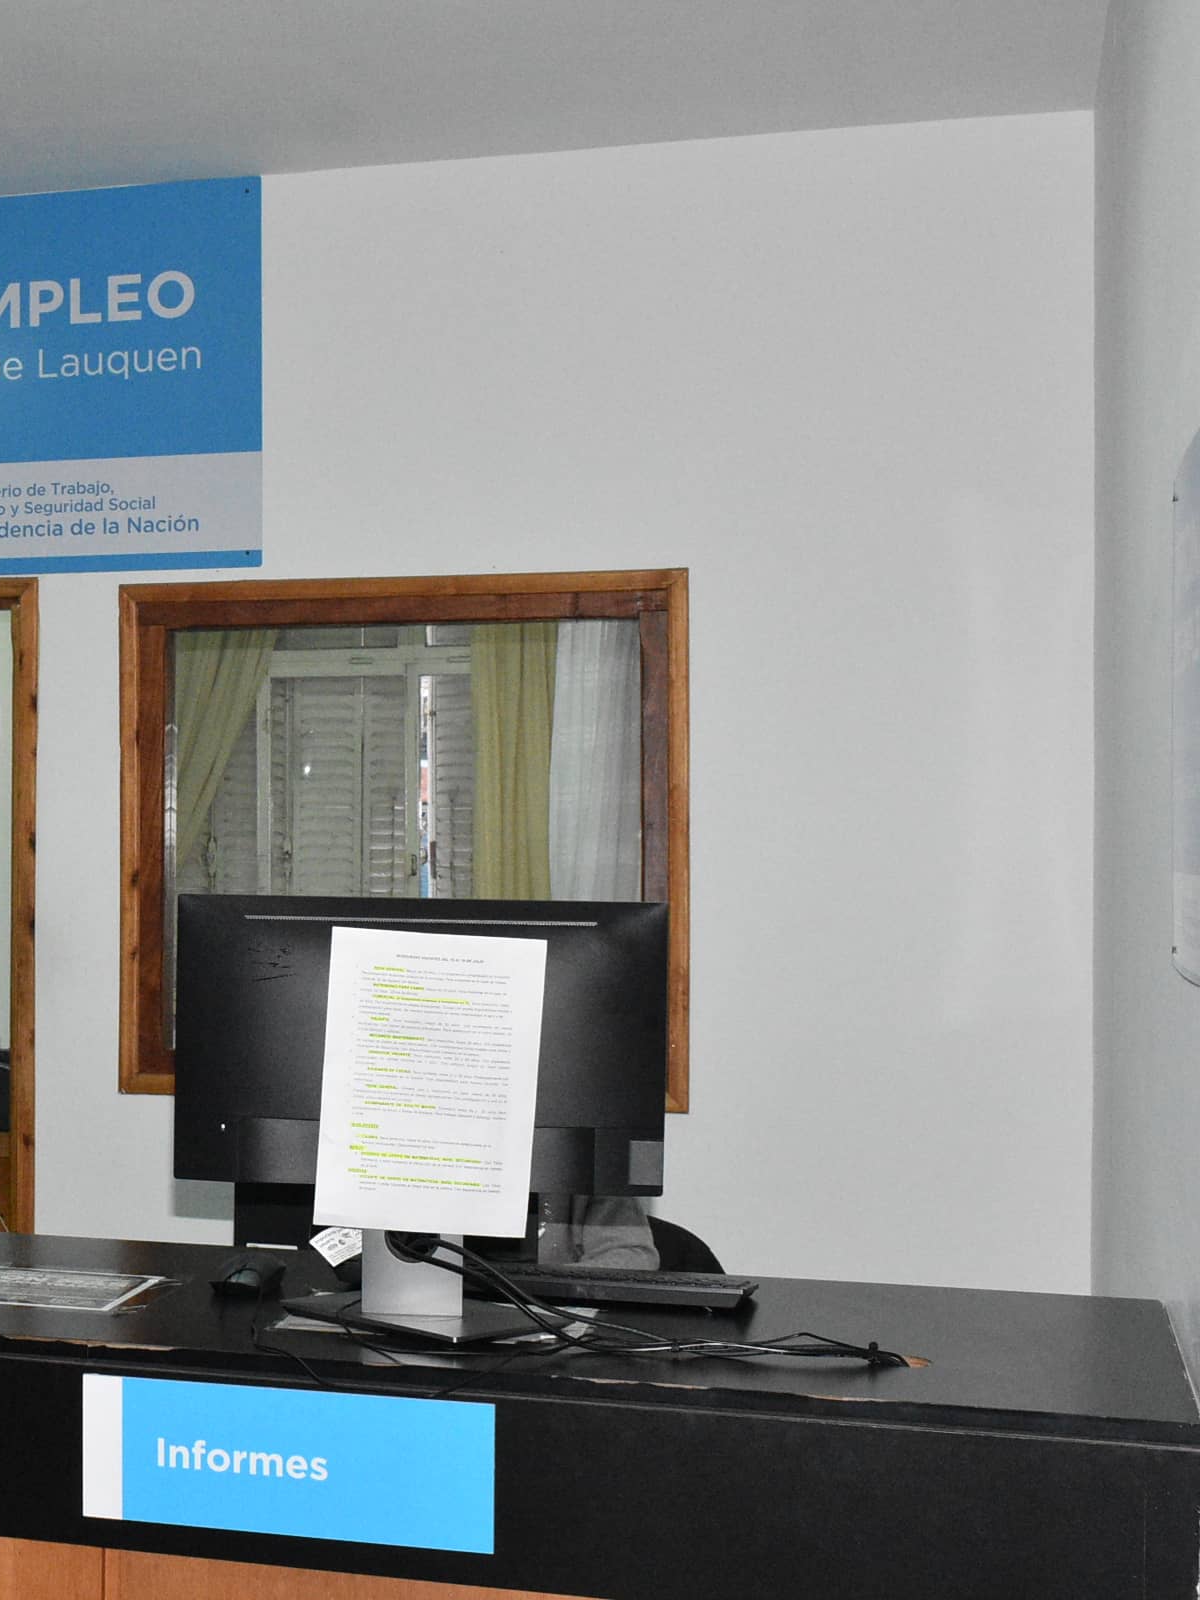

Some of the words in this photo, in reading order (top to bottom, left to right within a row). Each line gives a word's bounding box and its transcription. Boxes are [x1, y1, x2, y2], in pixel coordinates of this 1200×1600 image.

[38, 345, 202, 380] Lauquen
[26, 483, 46, 496] de
[50, 480, 115, 497] Trabajo,
[10, 506, 19, 518] y
[23, 498, 104, 516] Seguridad
[108, 496, 156, 511] Social
[70, 517, 97, 537] de
[102, 516, 121, 535] la
[126, 514, 200, 534] Nación
[156, 1436, 329, 1482] Informes
